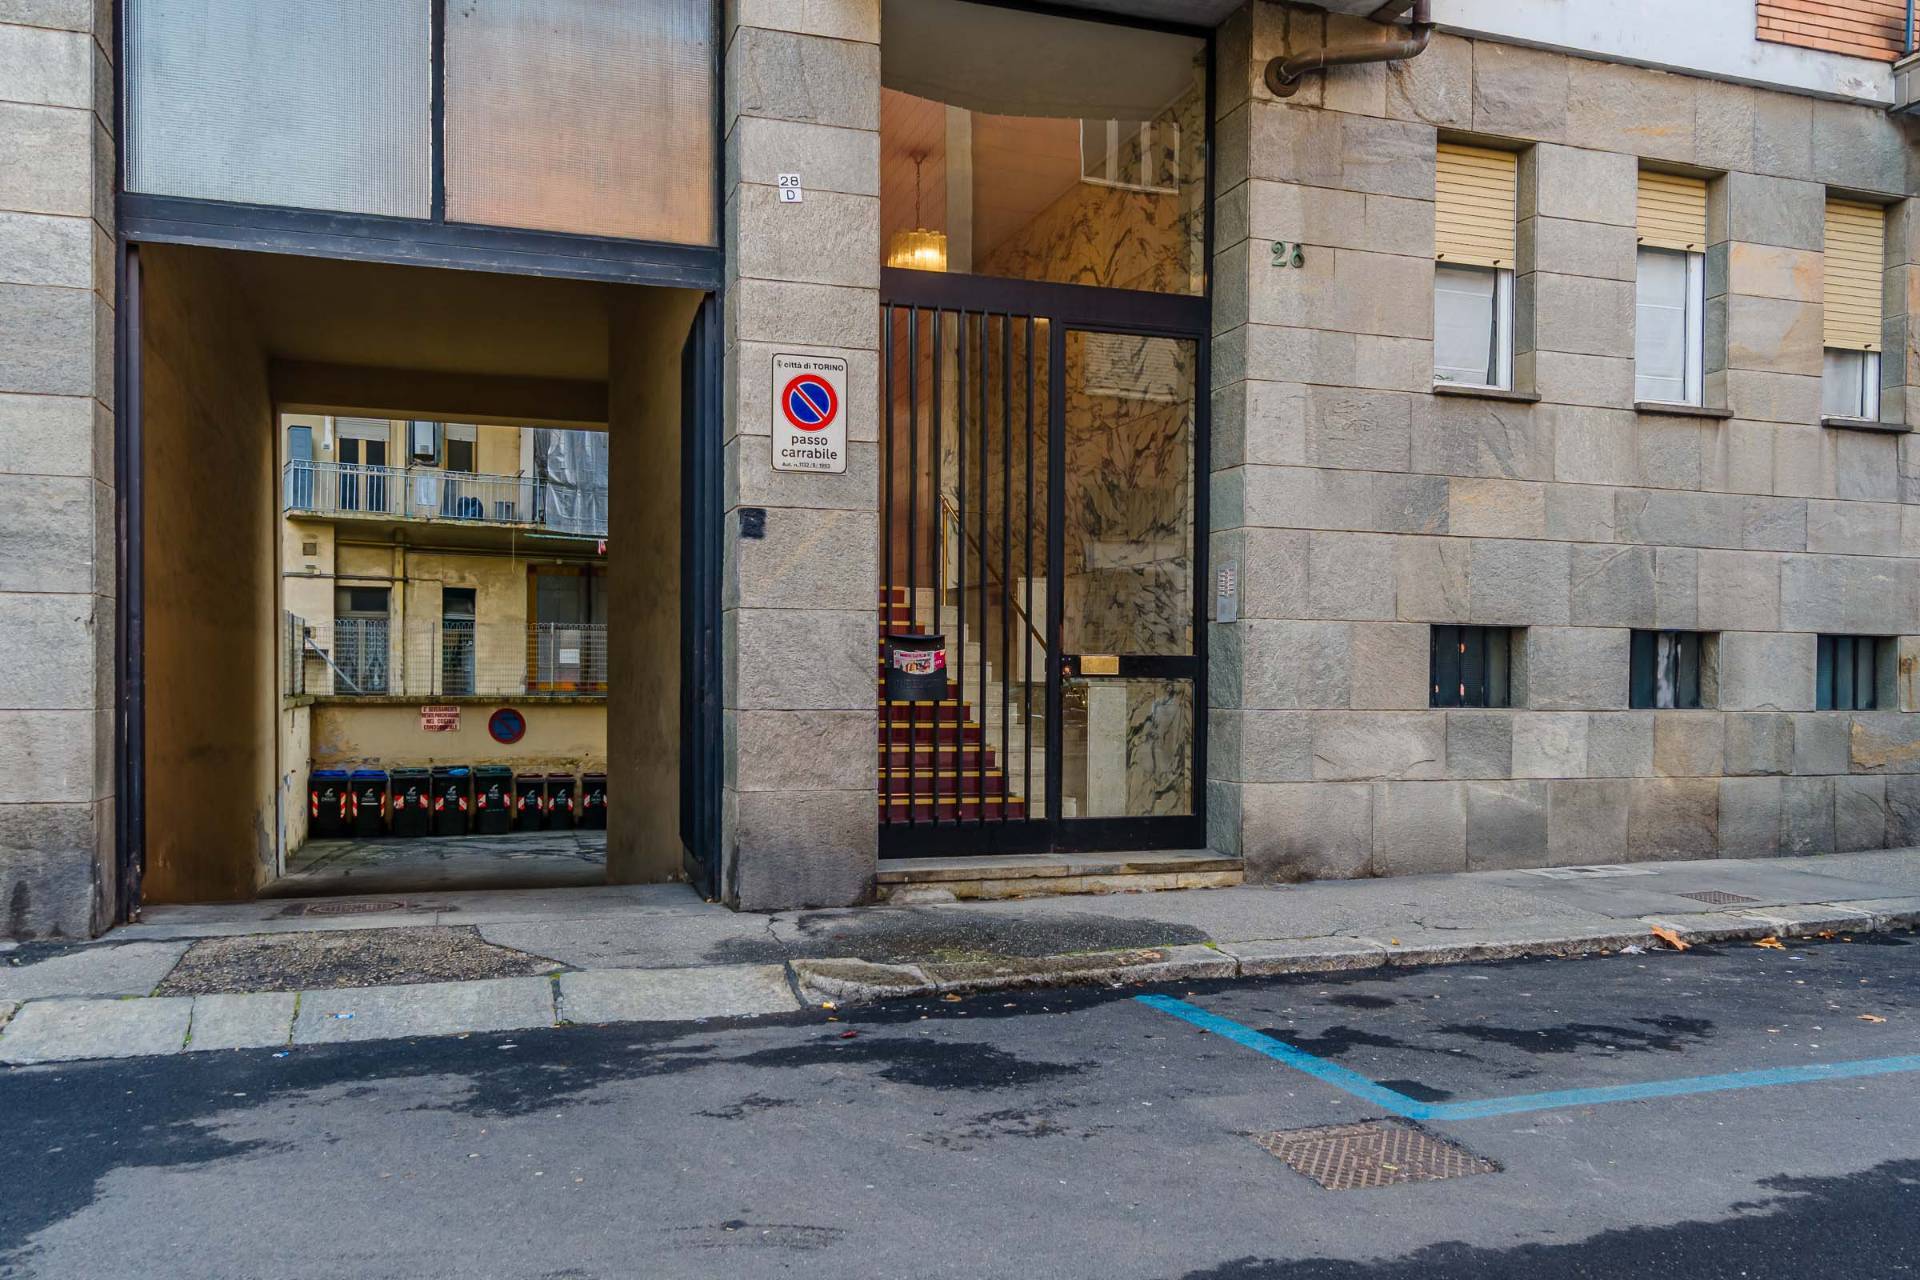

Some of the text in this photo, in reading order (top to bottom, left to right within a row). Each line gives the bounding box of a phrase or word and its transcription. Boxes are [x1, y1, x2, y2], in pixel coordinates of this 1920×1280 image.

[780, 176, 799, 186] 28
[786, 190, 796, 200] D
[1272, 241, 1305, 268] 28
[784, 361, 802, 369] città
[813, 363, 844, 372] TORINO
[791, 435, 828, 446] passo
[781, 448, 838, 460] carrabile
